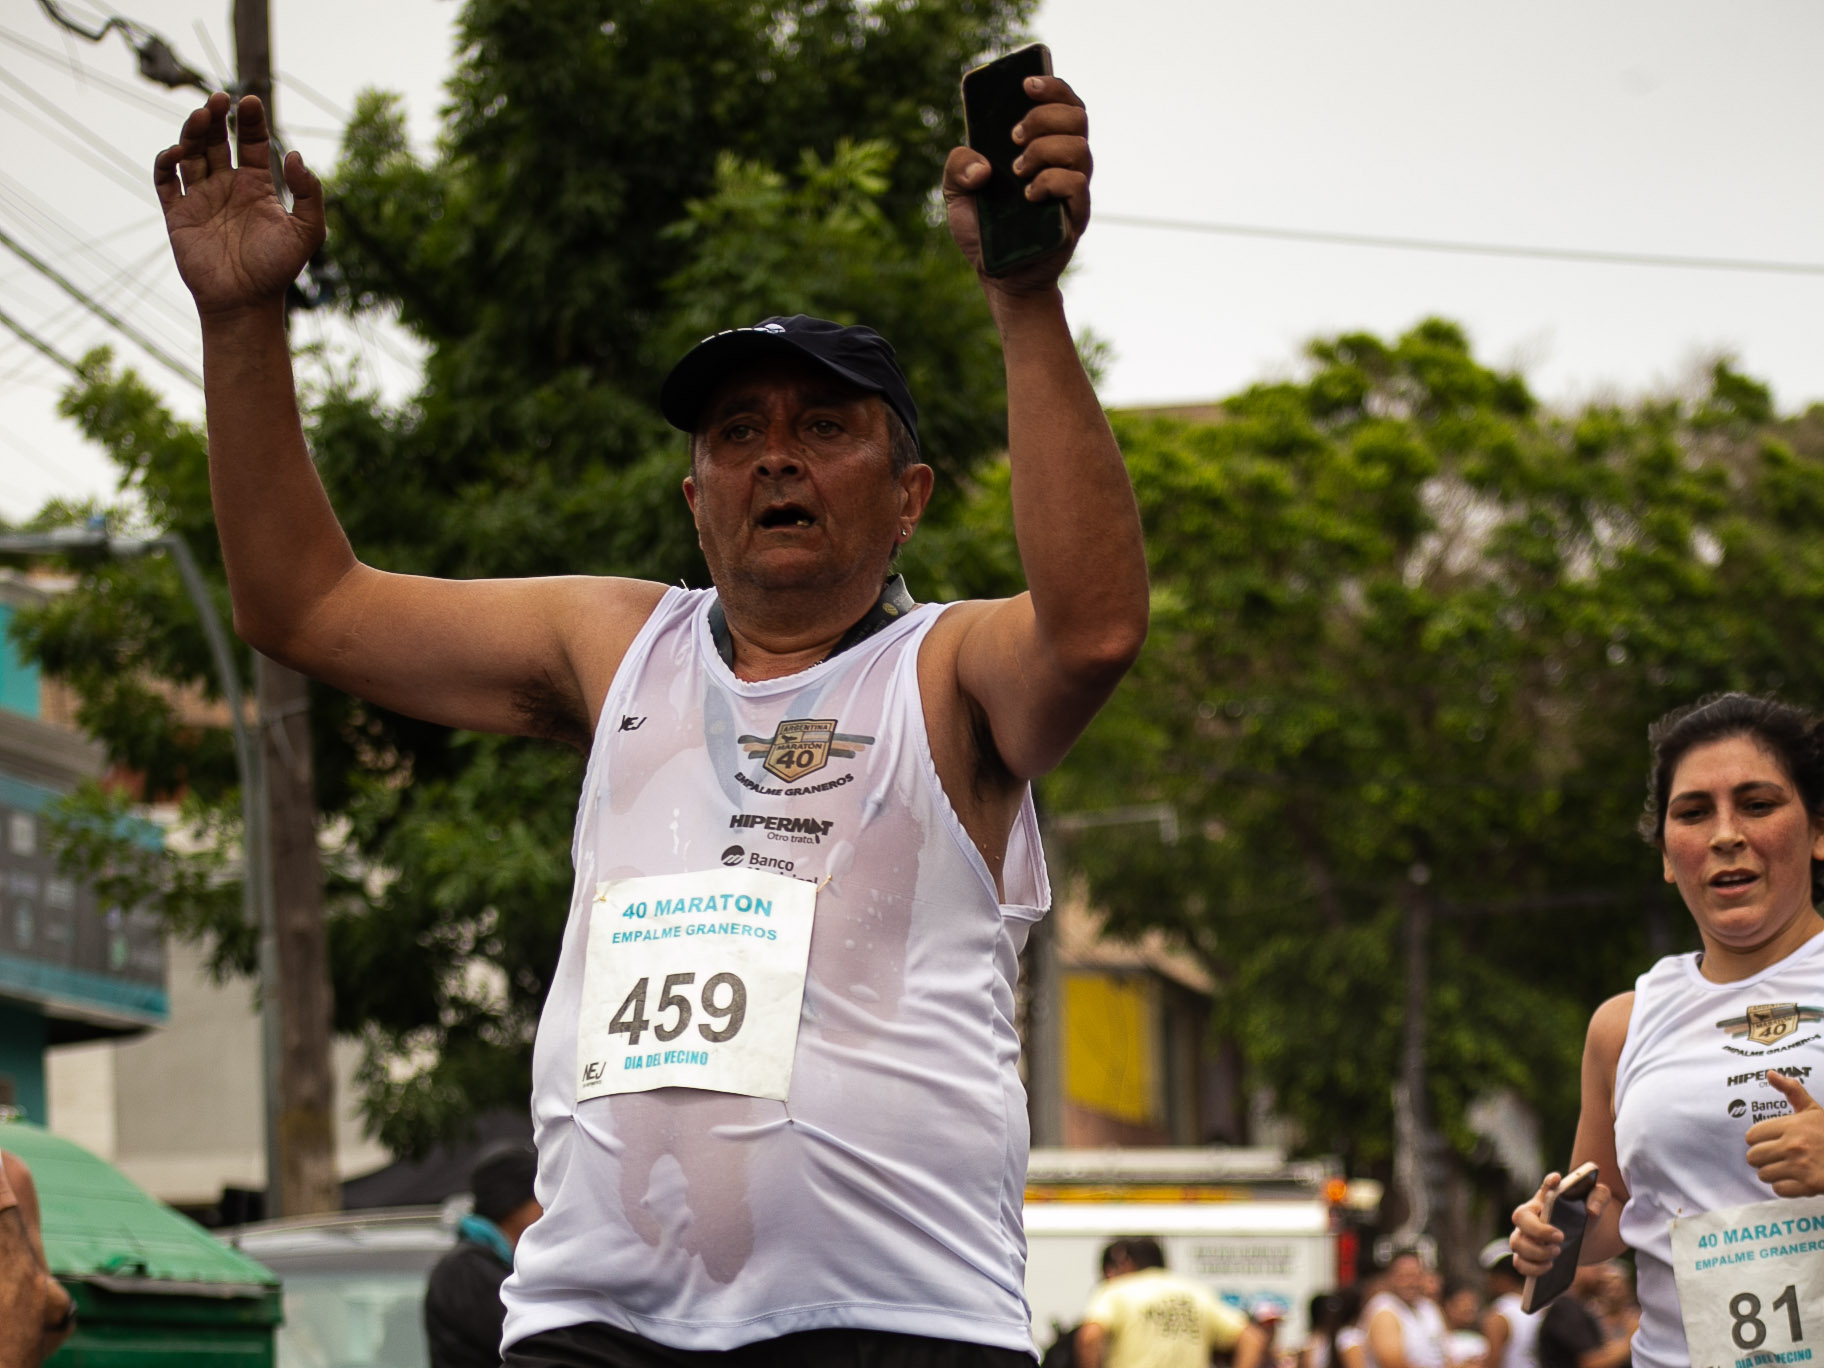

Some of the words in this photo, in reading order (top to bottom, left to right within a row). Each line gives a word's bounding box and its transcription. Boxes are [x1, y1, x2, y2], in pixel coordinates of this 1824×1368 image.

[783, 724, 828, 732] ARGENTINA
[776, 750, 814, 769] 40
[734, 771, 783, 796] EMPALME
[784, 773, 854, 796] GRANEROS
[767, 832, 789, 842] Otro
[749, 852, 795, 871] Banco
[622, 901, 648, 920] 40
[653, 894, 773, 918] MARATON
[612, 926, 682, 944] EMPALME
[685, 922, 778, 941] GRANEROS
[607, 972, 747, 1046] 459
[1759, 1023, 1787, 1038] 40
[624, 1055, 643, 1070] DIA
[645, 1053, 661, 1068] DEL
[664, 1050, 709, 1066] VECINO
[1727, 1065, 1812, 1087] HIPEMAT
[1751, 1100, 1788, 1113] Banco
[1698, 1233, 1718, 1249] 40
[1723, 1215, 1824, 1245] MARATON
[1695, 1251, 1755, 1271] EMPALME
[1729, 1284, 1803, 1351] 81
[1754, 1354, 1774, 1366] DEL
[1775, 1348, 1813, 1364] VECINO
